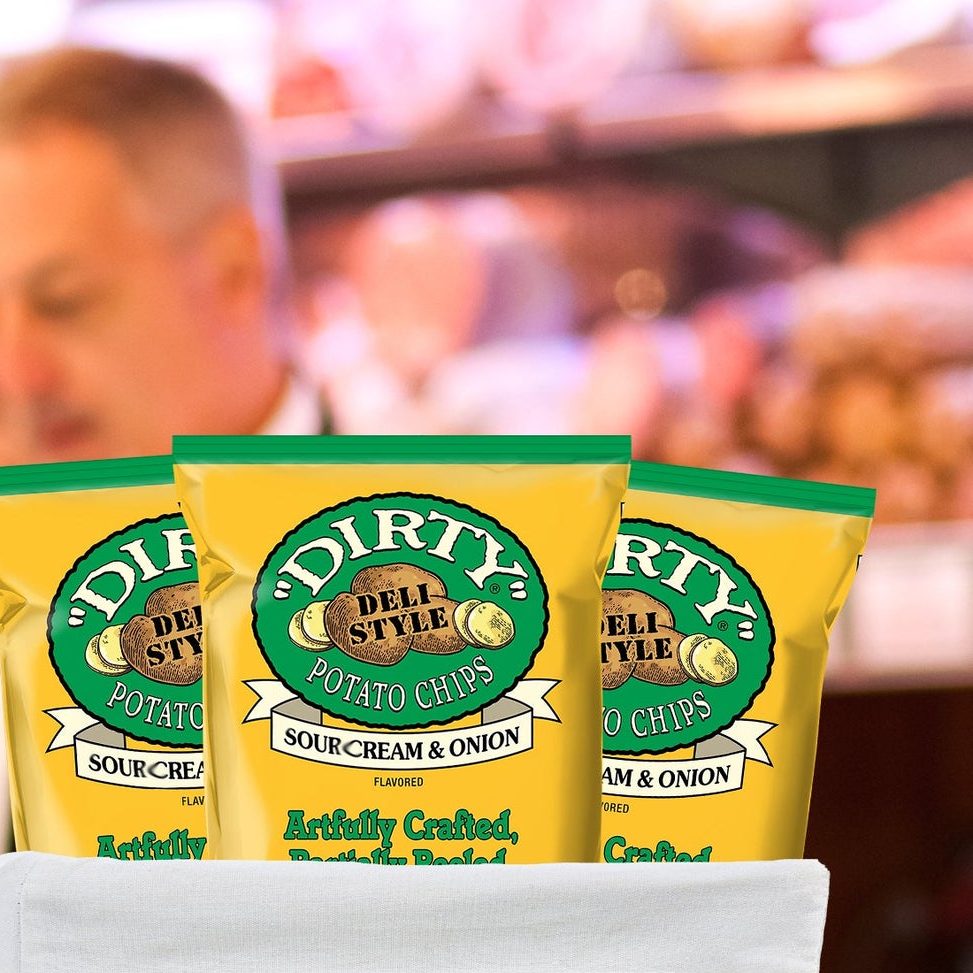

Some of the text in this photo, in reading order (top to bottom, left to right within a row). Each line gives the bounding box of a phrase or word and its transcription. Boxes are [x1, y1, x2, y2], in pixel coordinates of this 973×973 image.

[356, 583, 431, 617] DELI
[349, 606, 449, 646] STYLE
[601, 612, 659, 637] ELI
[305, 655, 494, 712] POTATO CHIPS
[630, 690, 712, 738] CHIPS
[284, 726, 520, 761] SOUR CREAM & ONION
[88, 753, 147, 778] SOUR
[373, 777, 424, 788] FLAVORED
[637, 769, 654, 788] &
[658, 765, 731, 788] ONION
[283, 808, 519, 848] Artfully Crafted,
